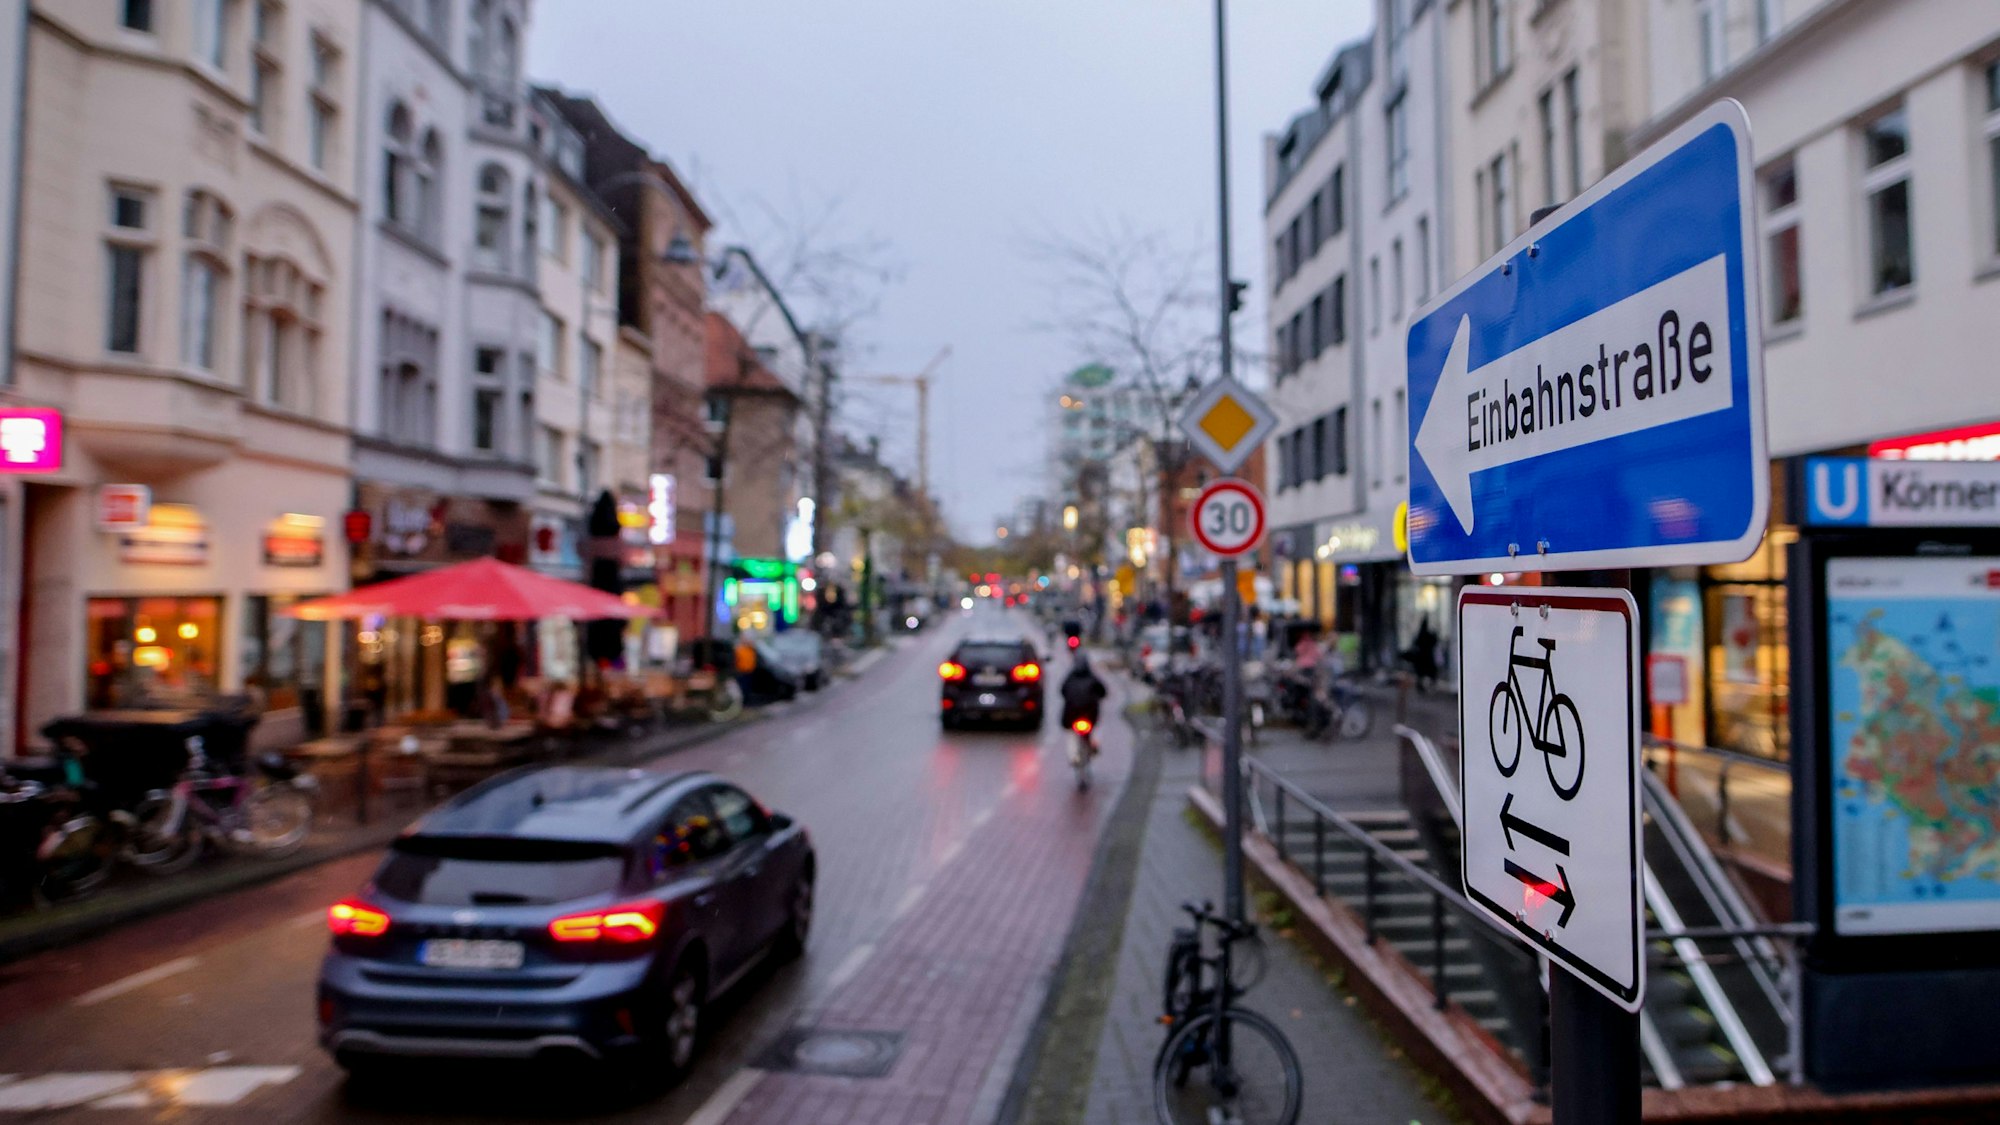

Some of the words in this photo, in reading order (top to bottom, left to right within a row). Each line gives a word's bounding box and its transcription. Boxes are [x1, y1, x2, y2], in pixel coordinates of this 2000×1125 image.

[1467, 309, 1713, 452] Einbahnstraße
[1208, 502, 1249, 535] 30
[1814, 462, 1859, 521] U
